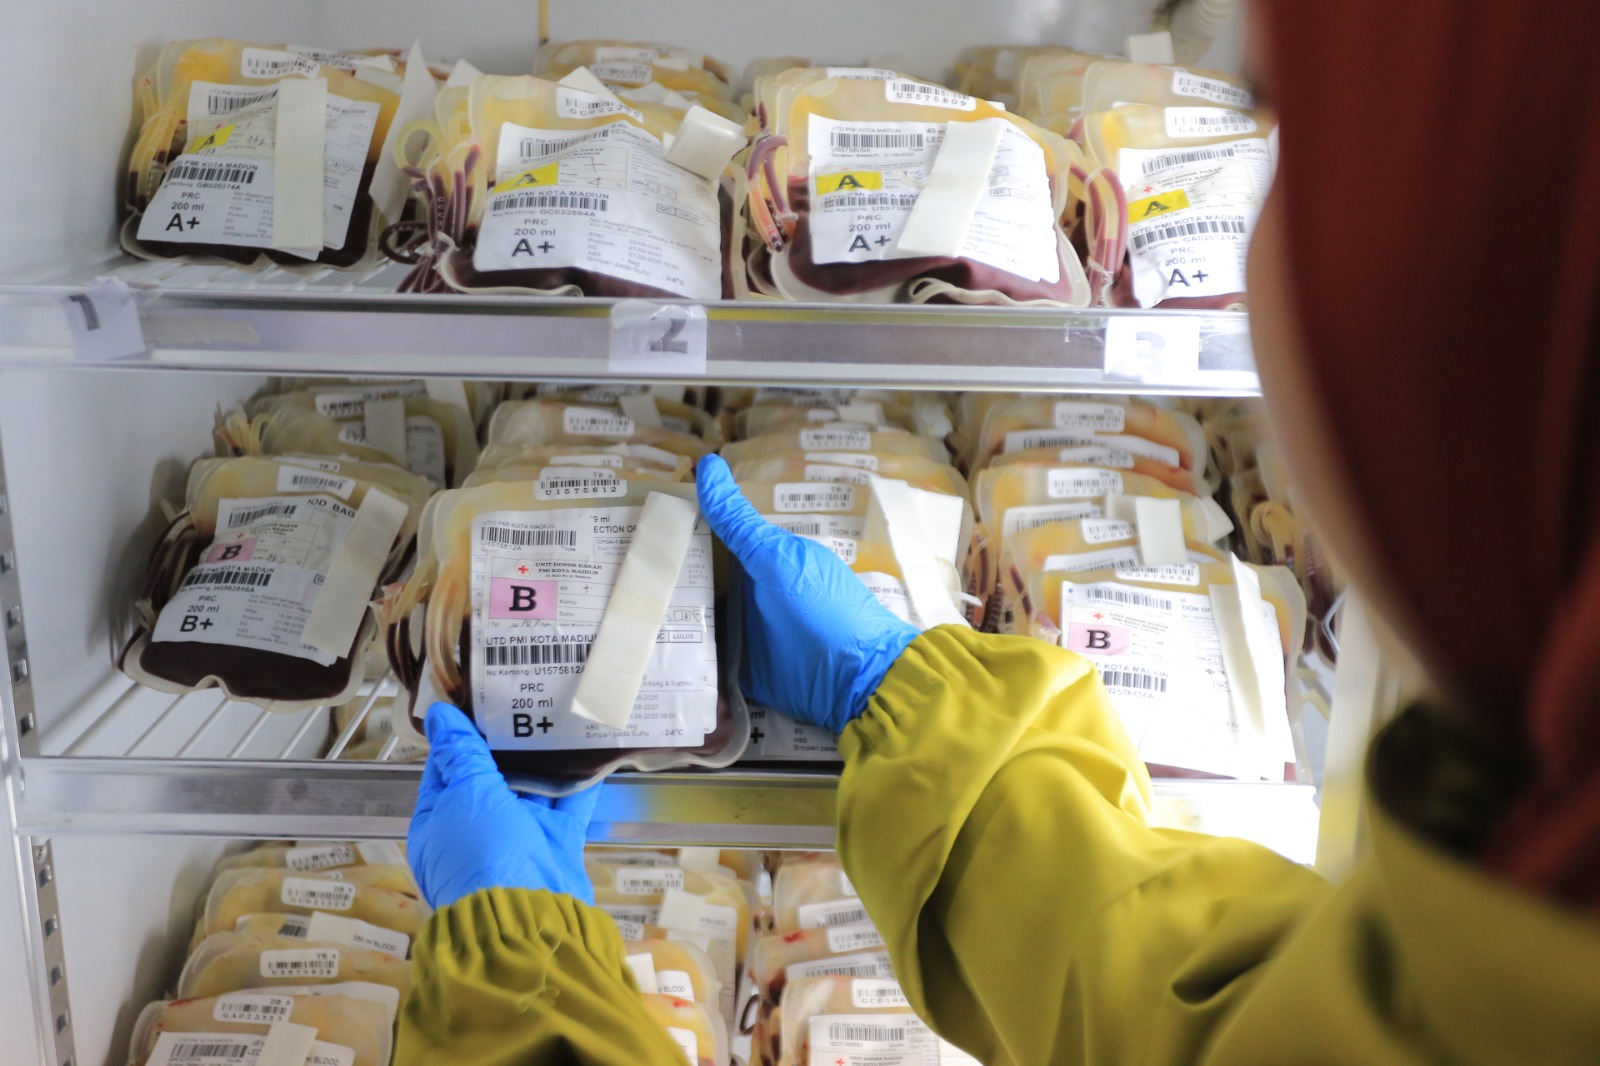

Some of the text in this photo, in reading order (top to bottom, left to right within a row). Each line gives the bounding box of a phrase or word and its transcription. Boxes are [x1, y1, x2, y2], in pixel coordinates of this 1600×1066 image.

[896, 92, 968, 107] U5575809
[201, 160, 223, 168] KOTA
[225, 160, 259, 171] MADIUN
[836, 174, 864, 191] A
[181, 191, 201, 200] PRC
[518, 190, 536, 198] PMI
[569, 190, 610, 200] MADIUN
[171, 202, 205, 212] 200 ml
[1143, 200, 1172, 218] A
[165, 212, 201, 232] A+
[523, 218, 550, 226] PRC
[849, 222, 891, 233] 200 ml
[1132, 214, 1246, 237] UTD PMI KOTA MADIUN
[513, 228, 556, 237] 200 ml
[511, 237, 556, 258] A+
[848, 233, 892, 253] A+
[1170, 246, 1196, 255] PRC
[1164, 256, 1207, 268] 200 ml
[1168, 268, 1209, 288] A+
[650, 315, 689, 355] 2
[1136, 330, 1167, 376] 3
[545, 487, 617, 497] U1575812
[600, 515, 610, 523] ml
[593, 525, 625, 534] ECTION
[217, 544, 243, 561] B
[221, 564, 242, 572] KOTA
[243, 566, 275, 574] MADIUN
[508, 584, 538, 612] B
[187, 604, 220, 613] 200 ml
[179, 614, 214, 633] B+
[486, 633, 598, 646] UTD PMI KOTA MADIU
[1085, 629, 1112, 650] B
[499, 667, 532, 676] Kantong:
[1104, 663, 1130, 671] KOTA
[520, 683, 545, 692] PRC
[511, 697, 553, 709] 200 ml
[750, 710, 766, 720] ml
[512, 713, 554, 738] B+
[585, 731, 613, 739] Simpan
[613, 731, 630, 739] pada
[663, 985, 686, 993] BLOOD
